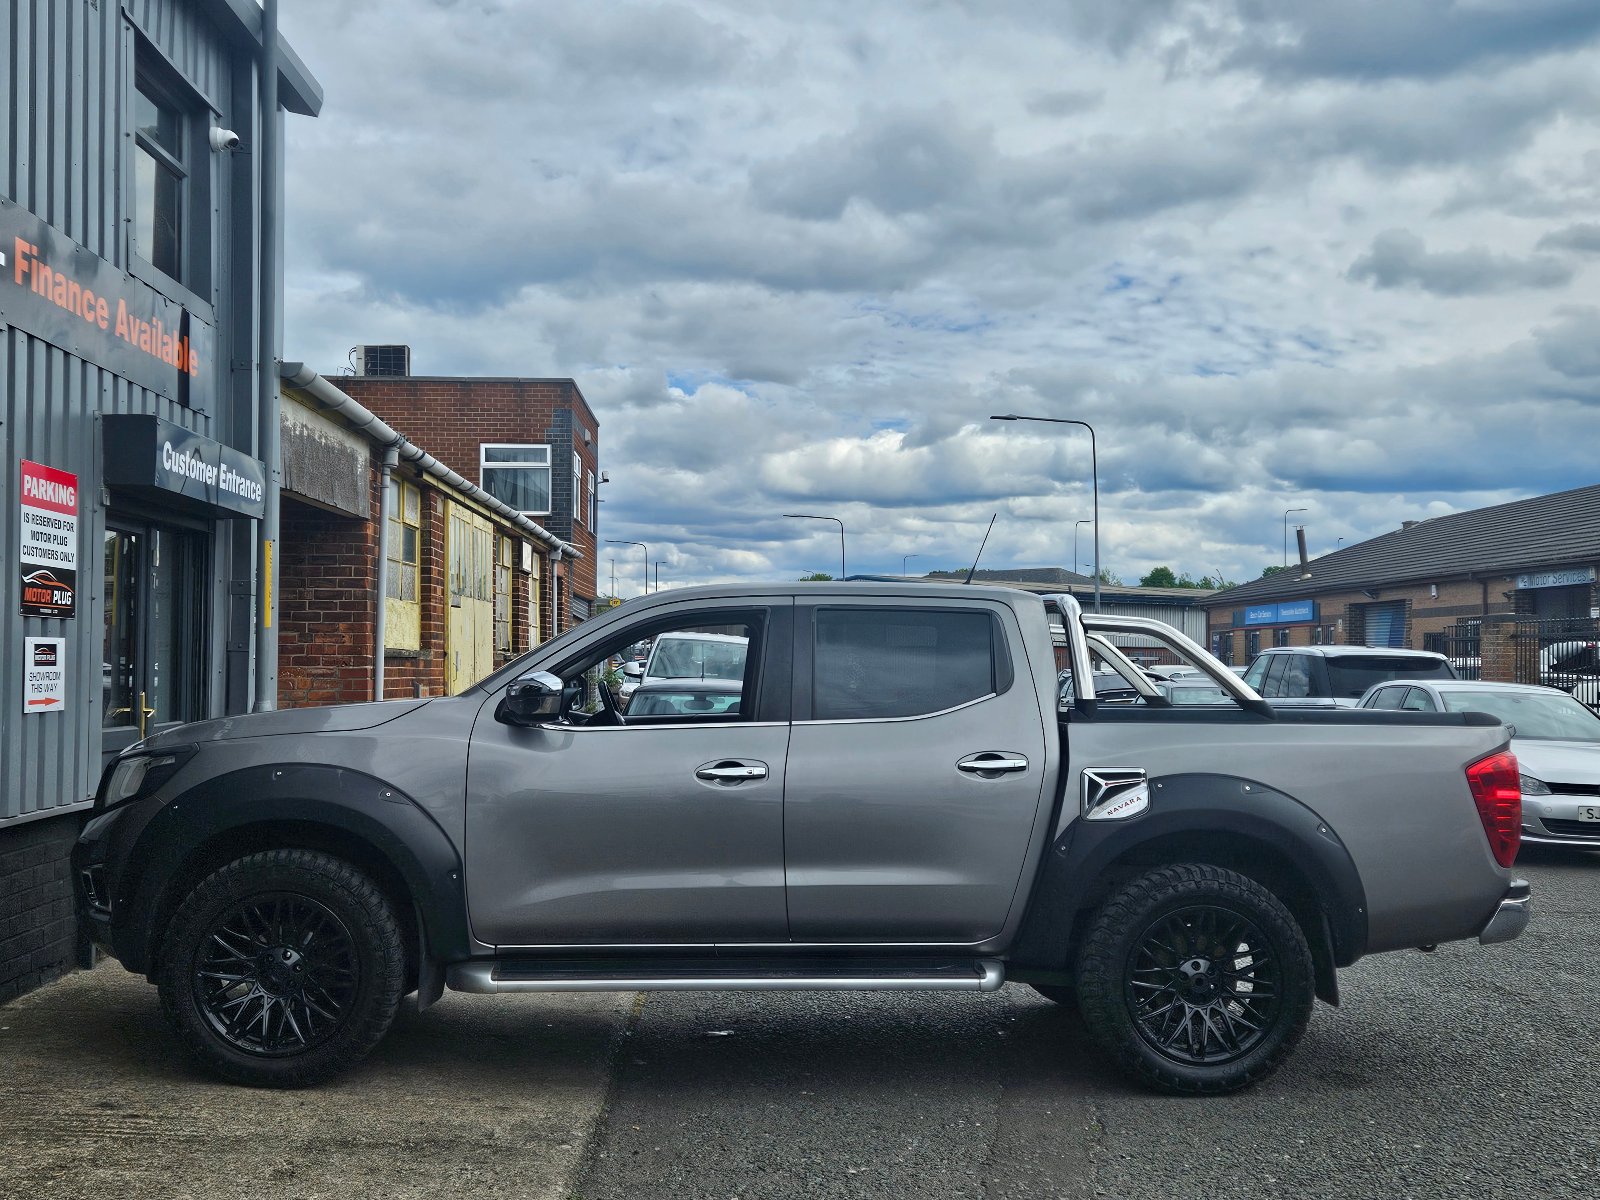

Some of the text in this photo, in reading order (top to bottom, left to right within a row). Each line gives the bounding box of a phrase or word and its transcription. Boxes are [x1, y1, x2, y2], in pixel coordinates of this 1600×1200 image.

[14, 236, 198, 377] Finance Available
[162, 441, 262, 502] Customer Entrance
[23, 474, 75, 507] PARKING
[23, 512, 75, 533] IS RESERVED FOR
[30, 530, 68, 547] MOTOR PLUG
[22, 544, 75, 563] CUSTOMERS ONLY
[24, 587, 72, 605] MOTOR PLUG
[29, 671, 61, 682] SHOWROOM
[31, 683, 58, 693] THIS WAY
[1107, 796, 1142, 816] NAVARA
